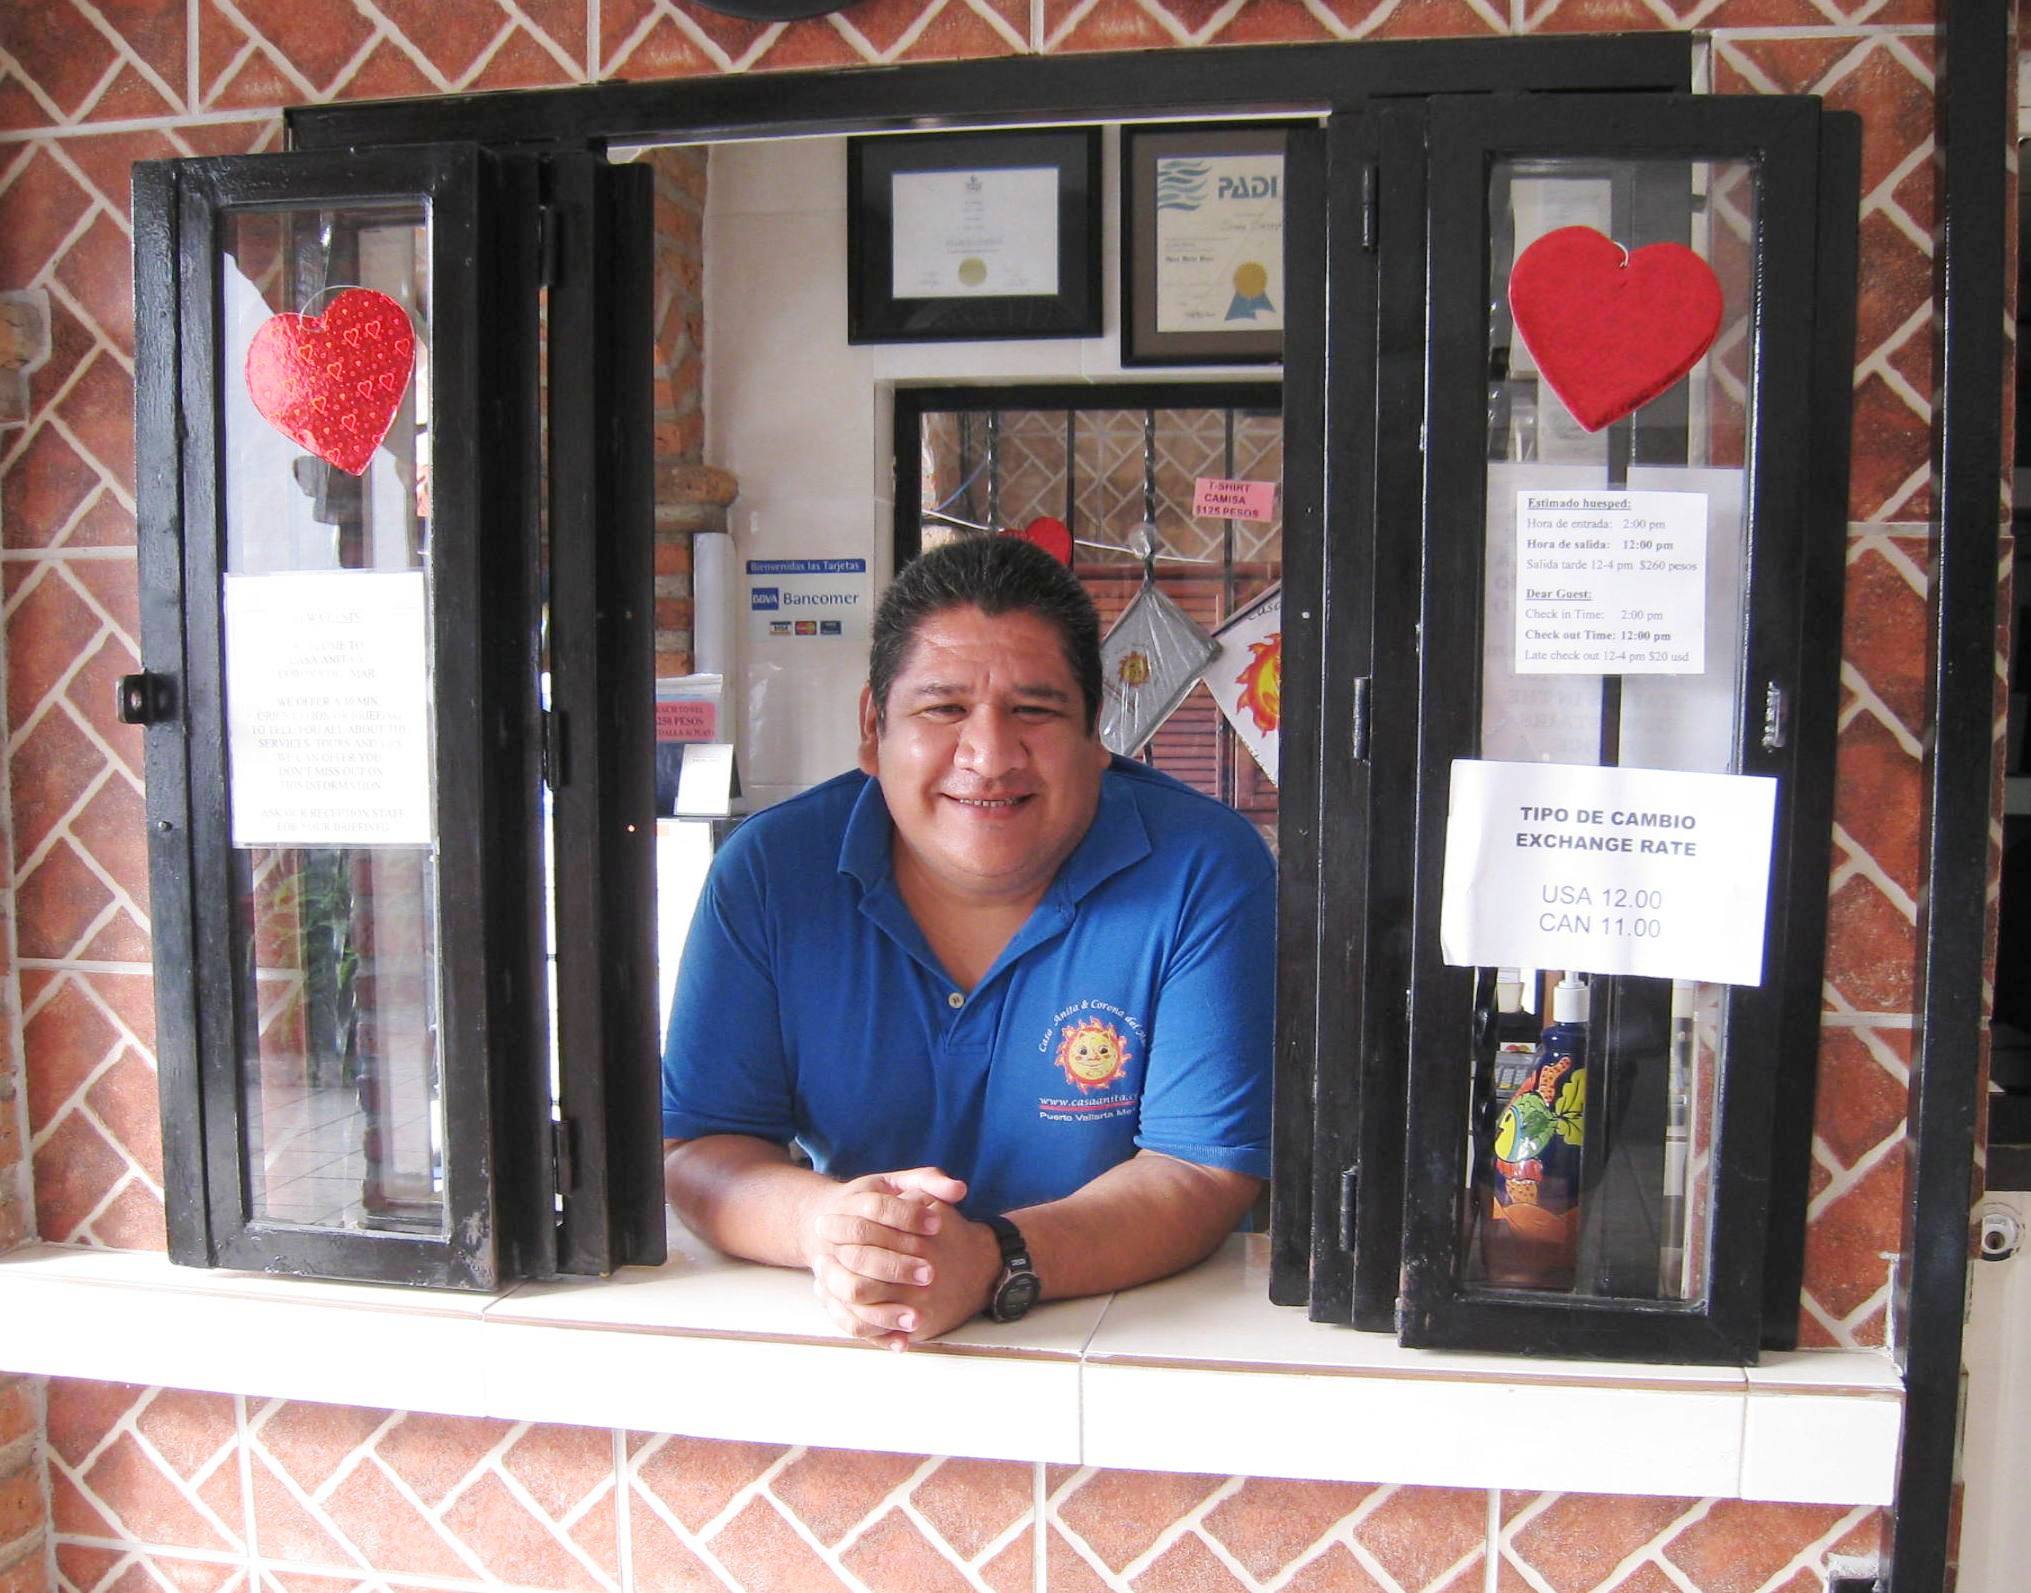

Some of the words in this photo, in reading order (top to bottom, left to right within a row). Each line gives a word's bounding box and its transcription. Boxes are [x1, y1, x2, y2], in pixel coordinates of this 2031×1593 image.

[1218, 176, 1277, 199] PADI
[1209, 481, 1250, 493] T-SHIRT
[1204, 493, 1246, 505] CAMISA
[1527, 498, 1579, 510] Estimado
[1583, 498, 1632, 510] huesped:
[1223, 506, 1260, 518] PESOS
[1527, 518, 1553, 529] Hora
[1556, 518, 1568, 529] de
[1571, 518, 1613, 529] entrada:
[1623, 519, 1646, 529] 2:00
[1649, 522, 1666, 531] pm
[1527, 540, 1555, 550] Hora
[1559, 540, 1571, 550] de
[1574, 540, 1610, 550] salida:
[1623, 540, 1653, 550] 12:00
[1656, 543, 1674, 551] pm
[807, 561, 820, 571] las
[823, 560, 860, 572] Tarjetas
[1526, 559, 1558, 570] Salida
[1561, 559, 1587, 570] tarde
[1591, 559, 1614, 570] 12-4
[1617, 562, 1633, 572] pm
[1640, 559, 1665, 571] $260
[1668, 561, 1698, 572] pesos
[783, 592, 859, 605] Bancomer
[1526, 589, 1553, 600] Dear
[1556, 589, 1592, 600] Guest:
[1525, 609, 1558, 619] Check
[1561, 609, 1571, 619] in
[1574, 609, 1605, 619] Time:
[1621, 610, 1644, 620] 2:00
[1647, 613, 1663, 622] pm
[1525, 629, 1559, 640] Check
[1563, 629, 1581, 640] out
[1584, 629, 1616, 640] Time:
[1621, 629, 1650, 640] 12:00
[1654, 633, 1671, 642] pm
[1524, 650, 1548, 660] Late
[1551, 650, 1579, 660] check
[1583, 650, 1600, 660] out
[1604, 651, 1626, 661] 12-4
[1629, 654, 1646, 663] pm
[1649, 650, 1668, 661] $20
[1671, 652, 1689, 662] usd
[1520, 806, 1568, 823] TIPO
[1576, 809, 1603, 825] DE
[1611, 810, 1696, 830] CAMBIO
[1516, 833, 1633, 853] EXCHANGE
[1640, 839, 1697, 857] RATE
[1542, 885, 1592, 906] USA
[1602, 888, 1663, 910] 12.00
[1539, 913, 1591, 934] CAN
[1602, 917, 1661, 939] 11.00
[1039, 1028, 1053, 1054] Casa
[1053, 1004, 1080, 1026] Anita
[1080, 999, 1089, 1010] &
[1090, 999, 1125, 1019] Corona
[1040, 1110, 1073, 1122] Puerto
[1075, 1110, 1114, 1121] Vallarta
